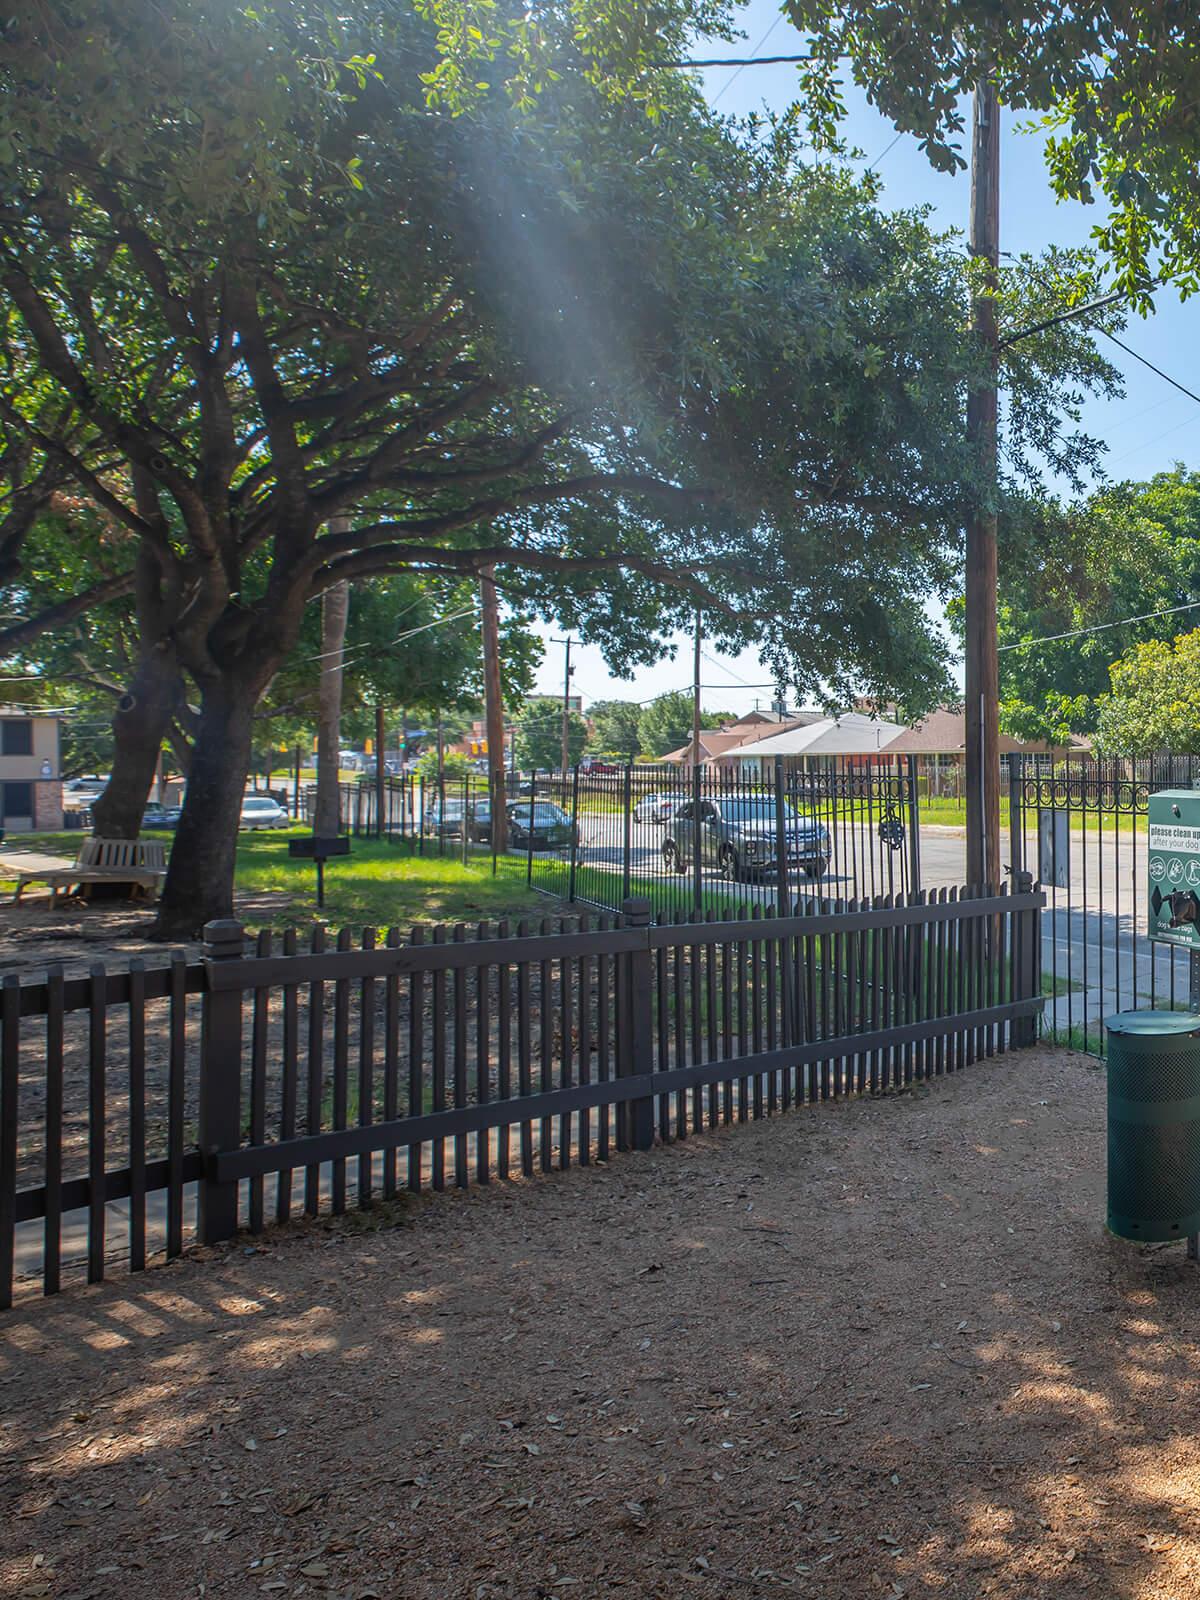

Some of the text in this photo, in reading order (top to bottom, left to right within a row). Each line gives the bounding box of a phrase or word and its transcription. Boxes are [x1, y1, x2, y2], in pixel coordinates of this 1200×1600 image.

[1151, 826, 1200, 840] please clean up
[1152, 837, 1199, 849] after your dog
[1157, 921, 1167, 930] dog
